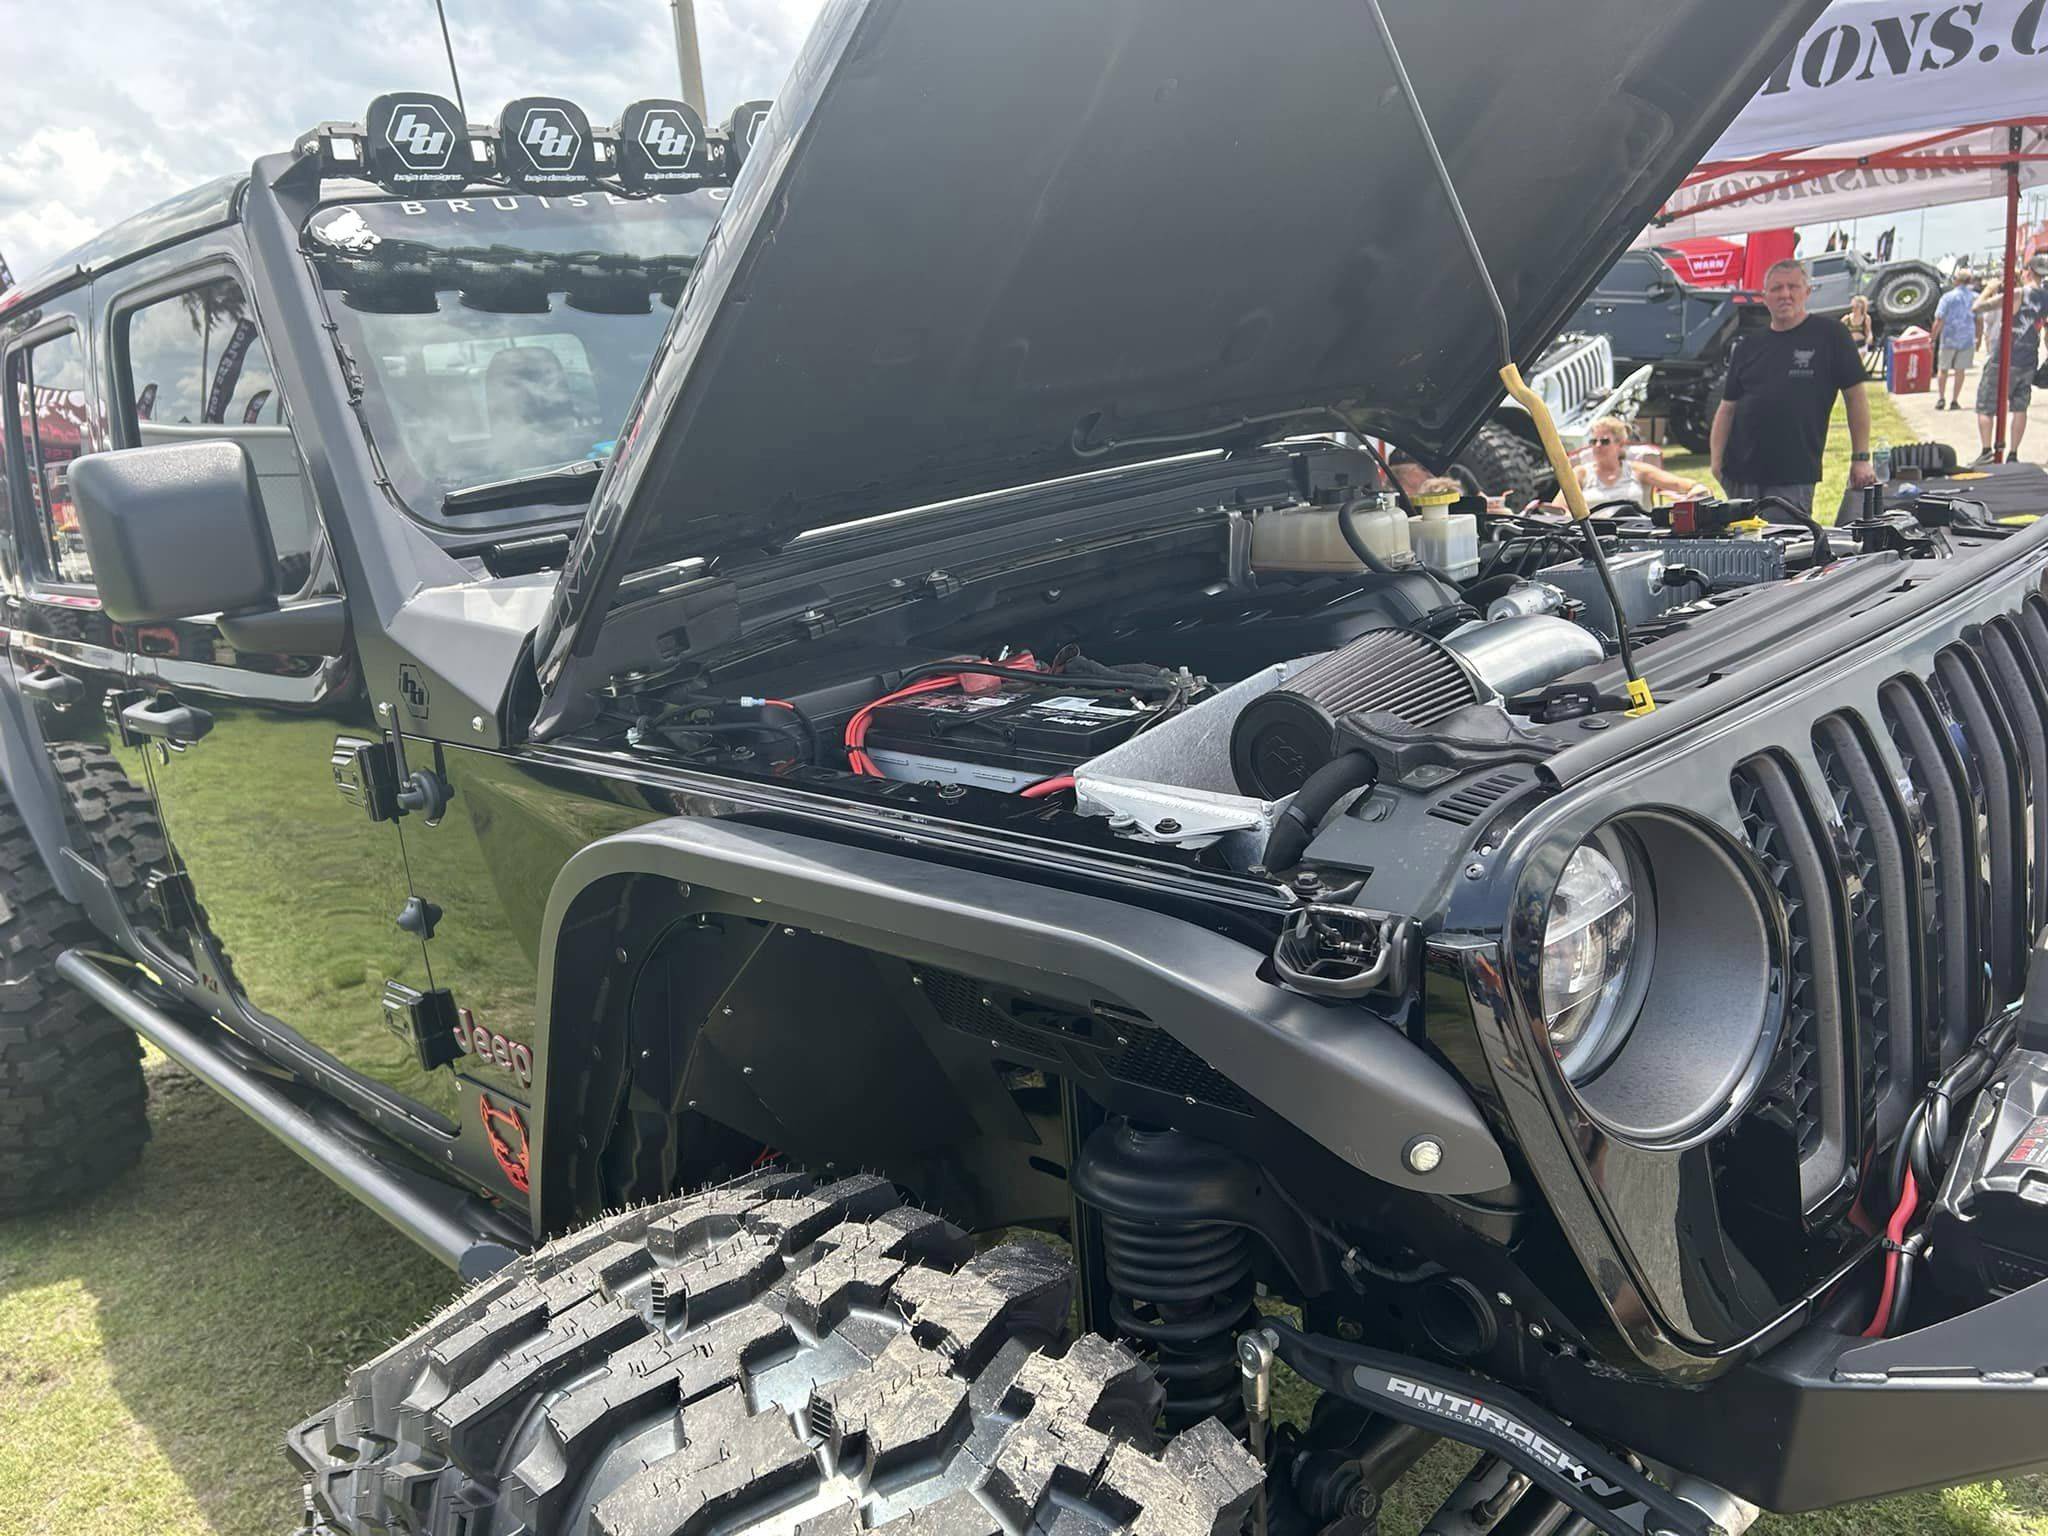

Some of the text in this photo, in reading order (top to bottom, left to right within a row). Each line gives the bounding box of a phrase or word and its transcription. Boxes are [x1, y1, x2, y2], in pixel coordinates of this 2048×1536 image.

[393, 172, 418, 183] baja
[524, 173, 547, 183] baja
[644, 172, 664, 181] baja
[1693, 259, 1725, 271] WARN
[453, 1007, 534, 1089] Jeep
[1417, 1401, 1551, 1467] OFFROAD SWAYBAR
